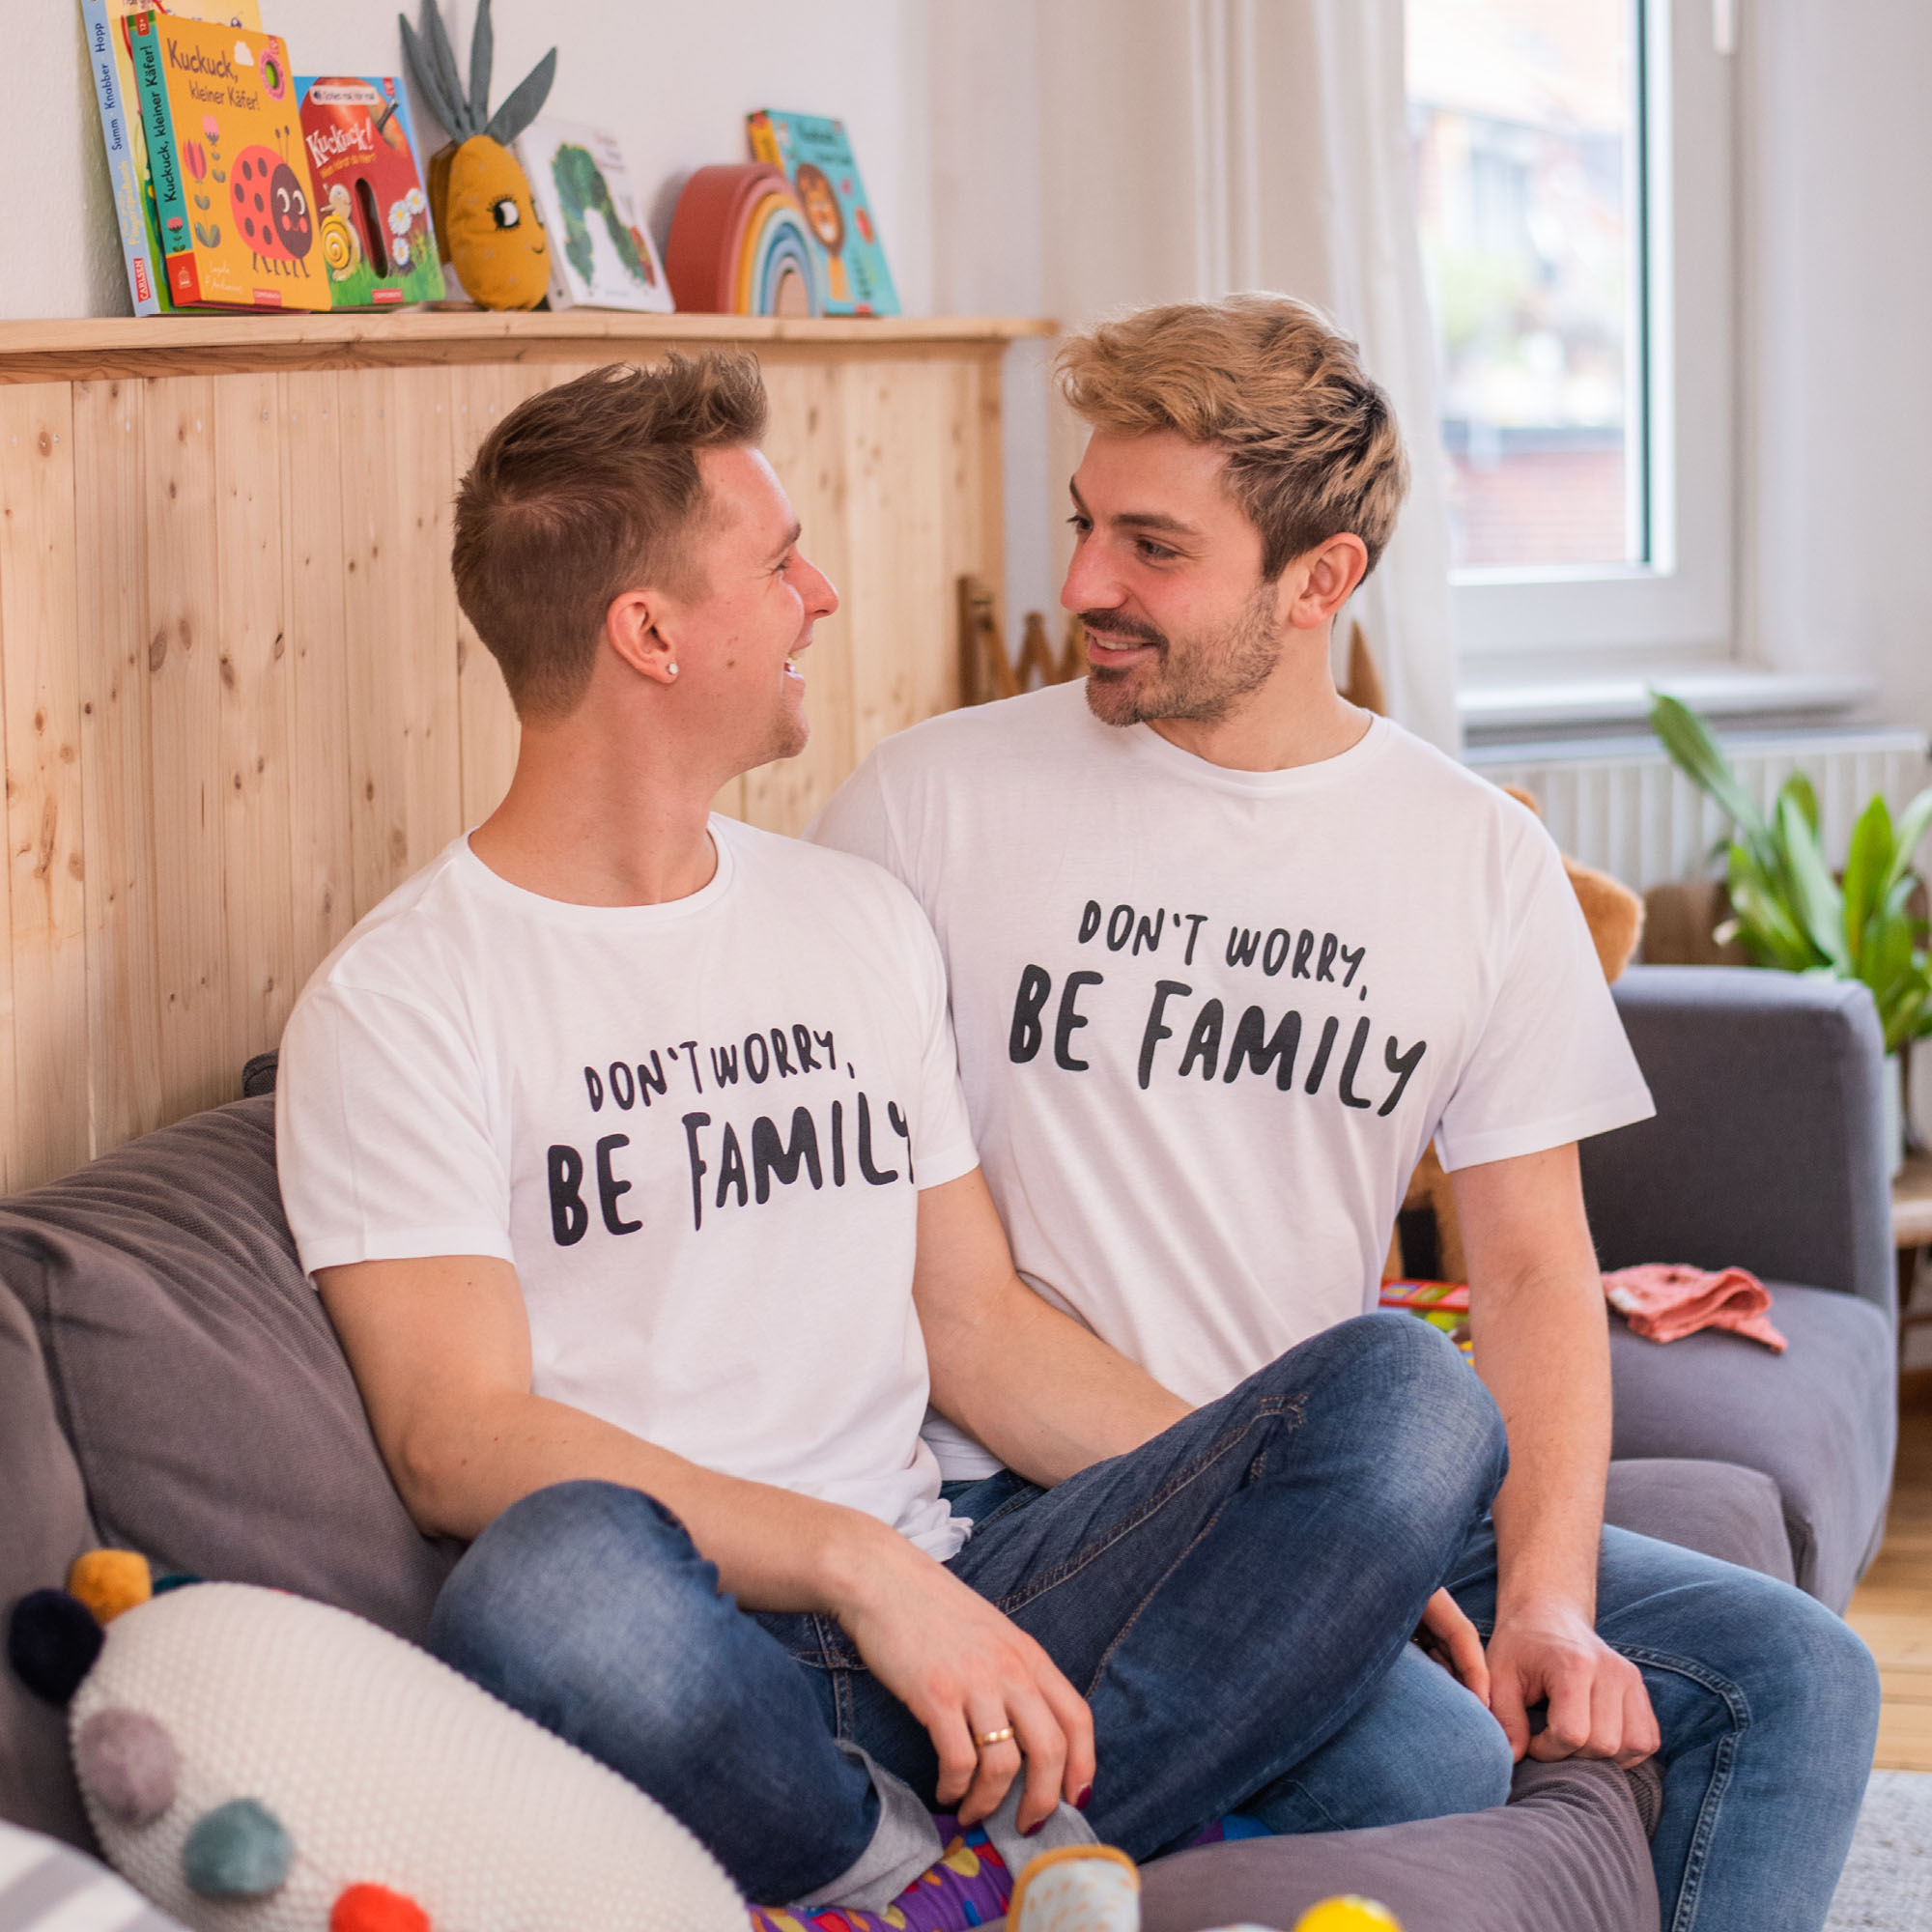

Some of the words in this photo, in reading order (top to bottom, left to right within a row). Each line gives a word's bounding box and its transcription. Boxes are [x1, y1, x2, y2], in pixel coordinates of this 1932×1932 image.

[95, 23, 106, 52] Hopp
[166, 38, 239, 84] Kuckuck,
[100, 63, 116, 110] Knabber
[140, 44, 157, 88] Käfer!
[151, 92, 166, 138] kleiner
[188, 79, 225, 105] kleiner
[227, 86, 261, 112] Käfer!
[111, 118, 123, 151] Summ
[305, 116, 375, 169] Kuckuck!
[157, 141, 177, 203] Kuckuck,
[1078, 899, 1208, 966] DON'T
[1225, 925, 1367, 1001] WORRY,
[1009, 963, 1103, 1071] BE
[1137, 979, 1427, 1117] FAMILY
[583, 1040, 703, 1112] DON'T
[710, 1024, 855, 1089] WORRY,
[547, 1133, 643, 1246] BE
[681, 1092, 914, 1232] FAMILY
